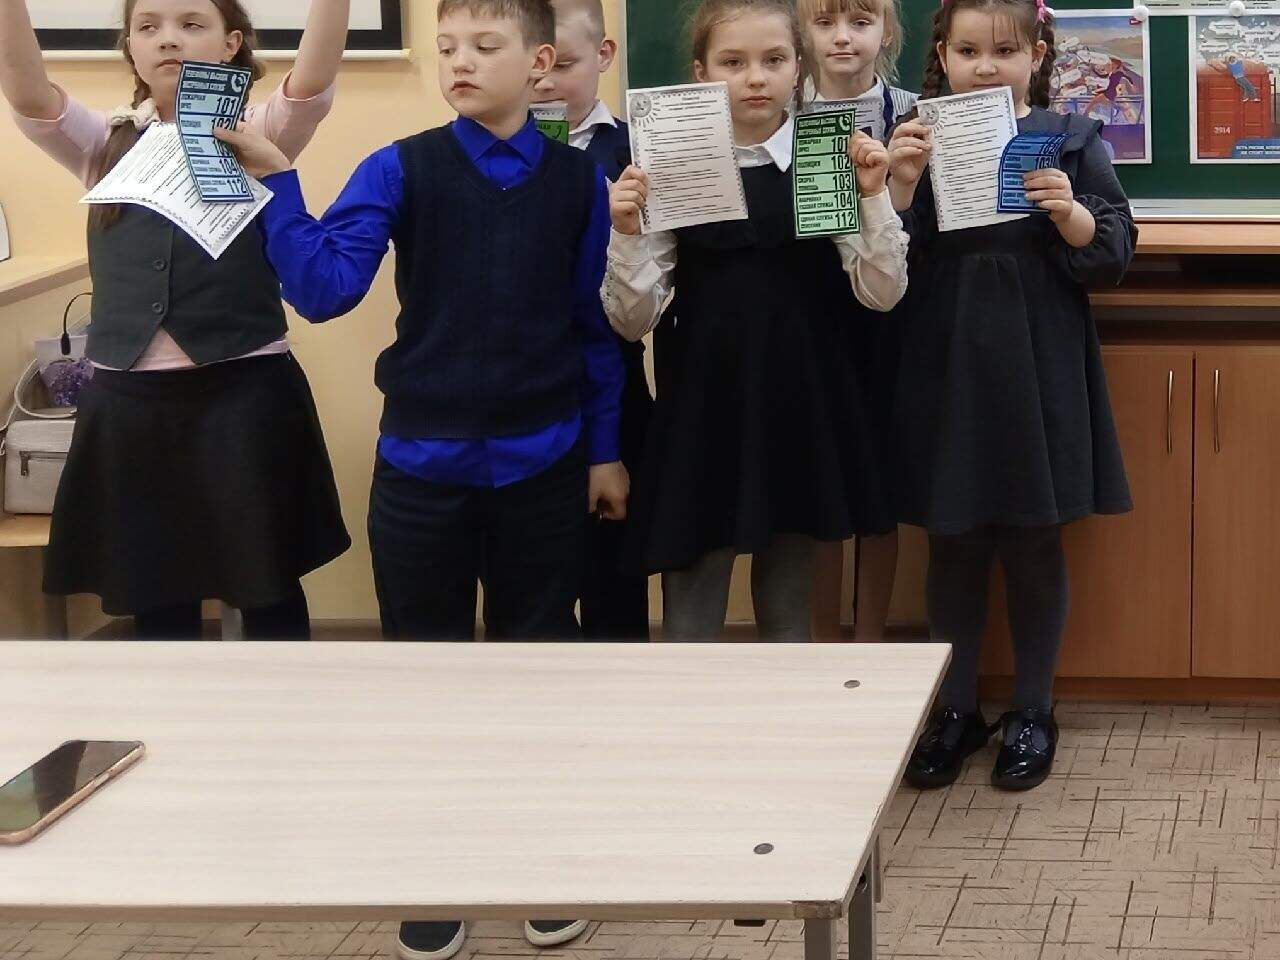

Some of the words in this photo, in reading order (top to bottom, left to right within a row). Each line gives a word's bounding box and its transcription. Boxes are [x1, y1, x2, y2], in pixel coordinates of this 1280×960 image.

[216, 97, 237, 115] 101
[831, 137, 848, 153] 101
[831, 154, 850, 170] 102
[833, 174, 850, 190] 103
[834, 192, 852, 208] 104
[835, 212, 854, 227] 112
